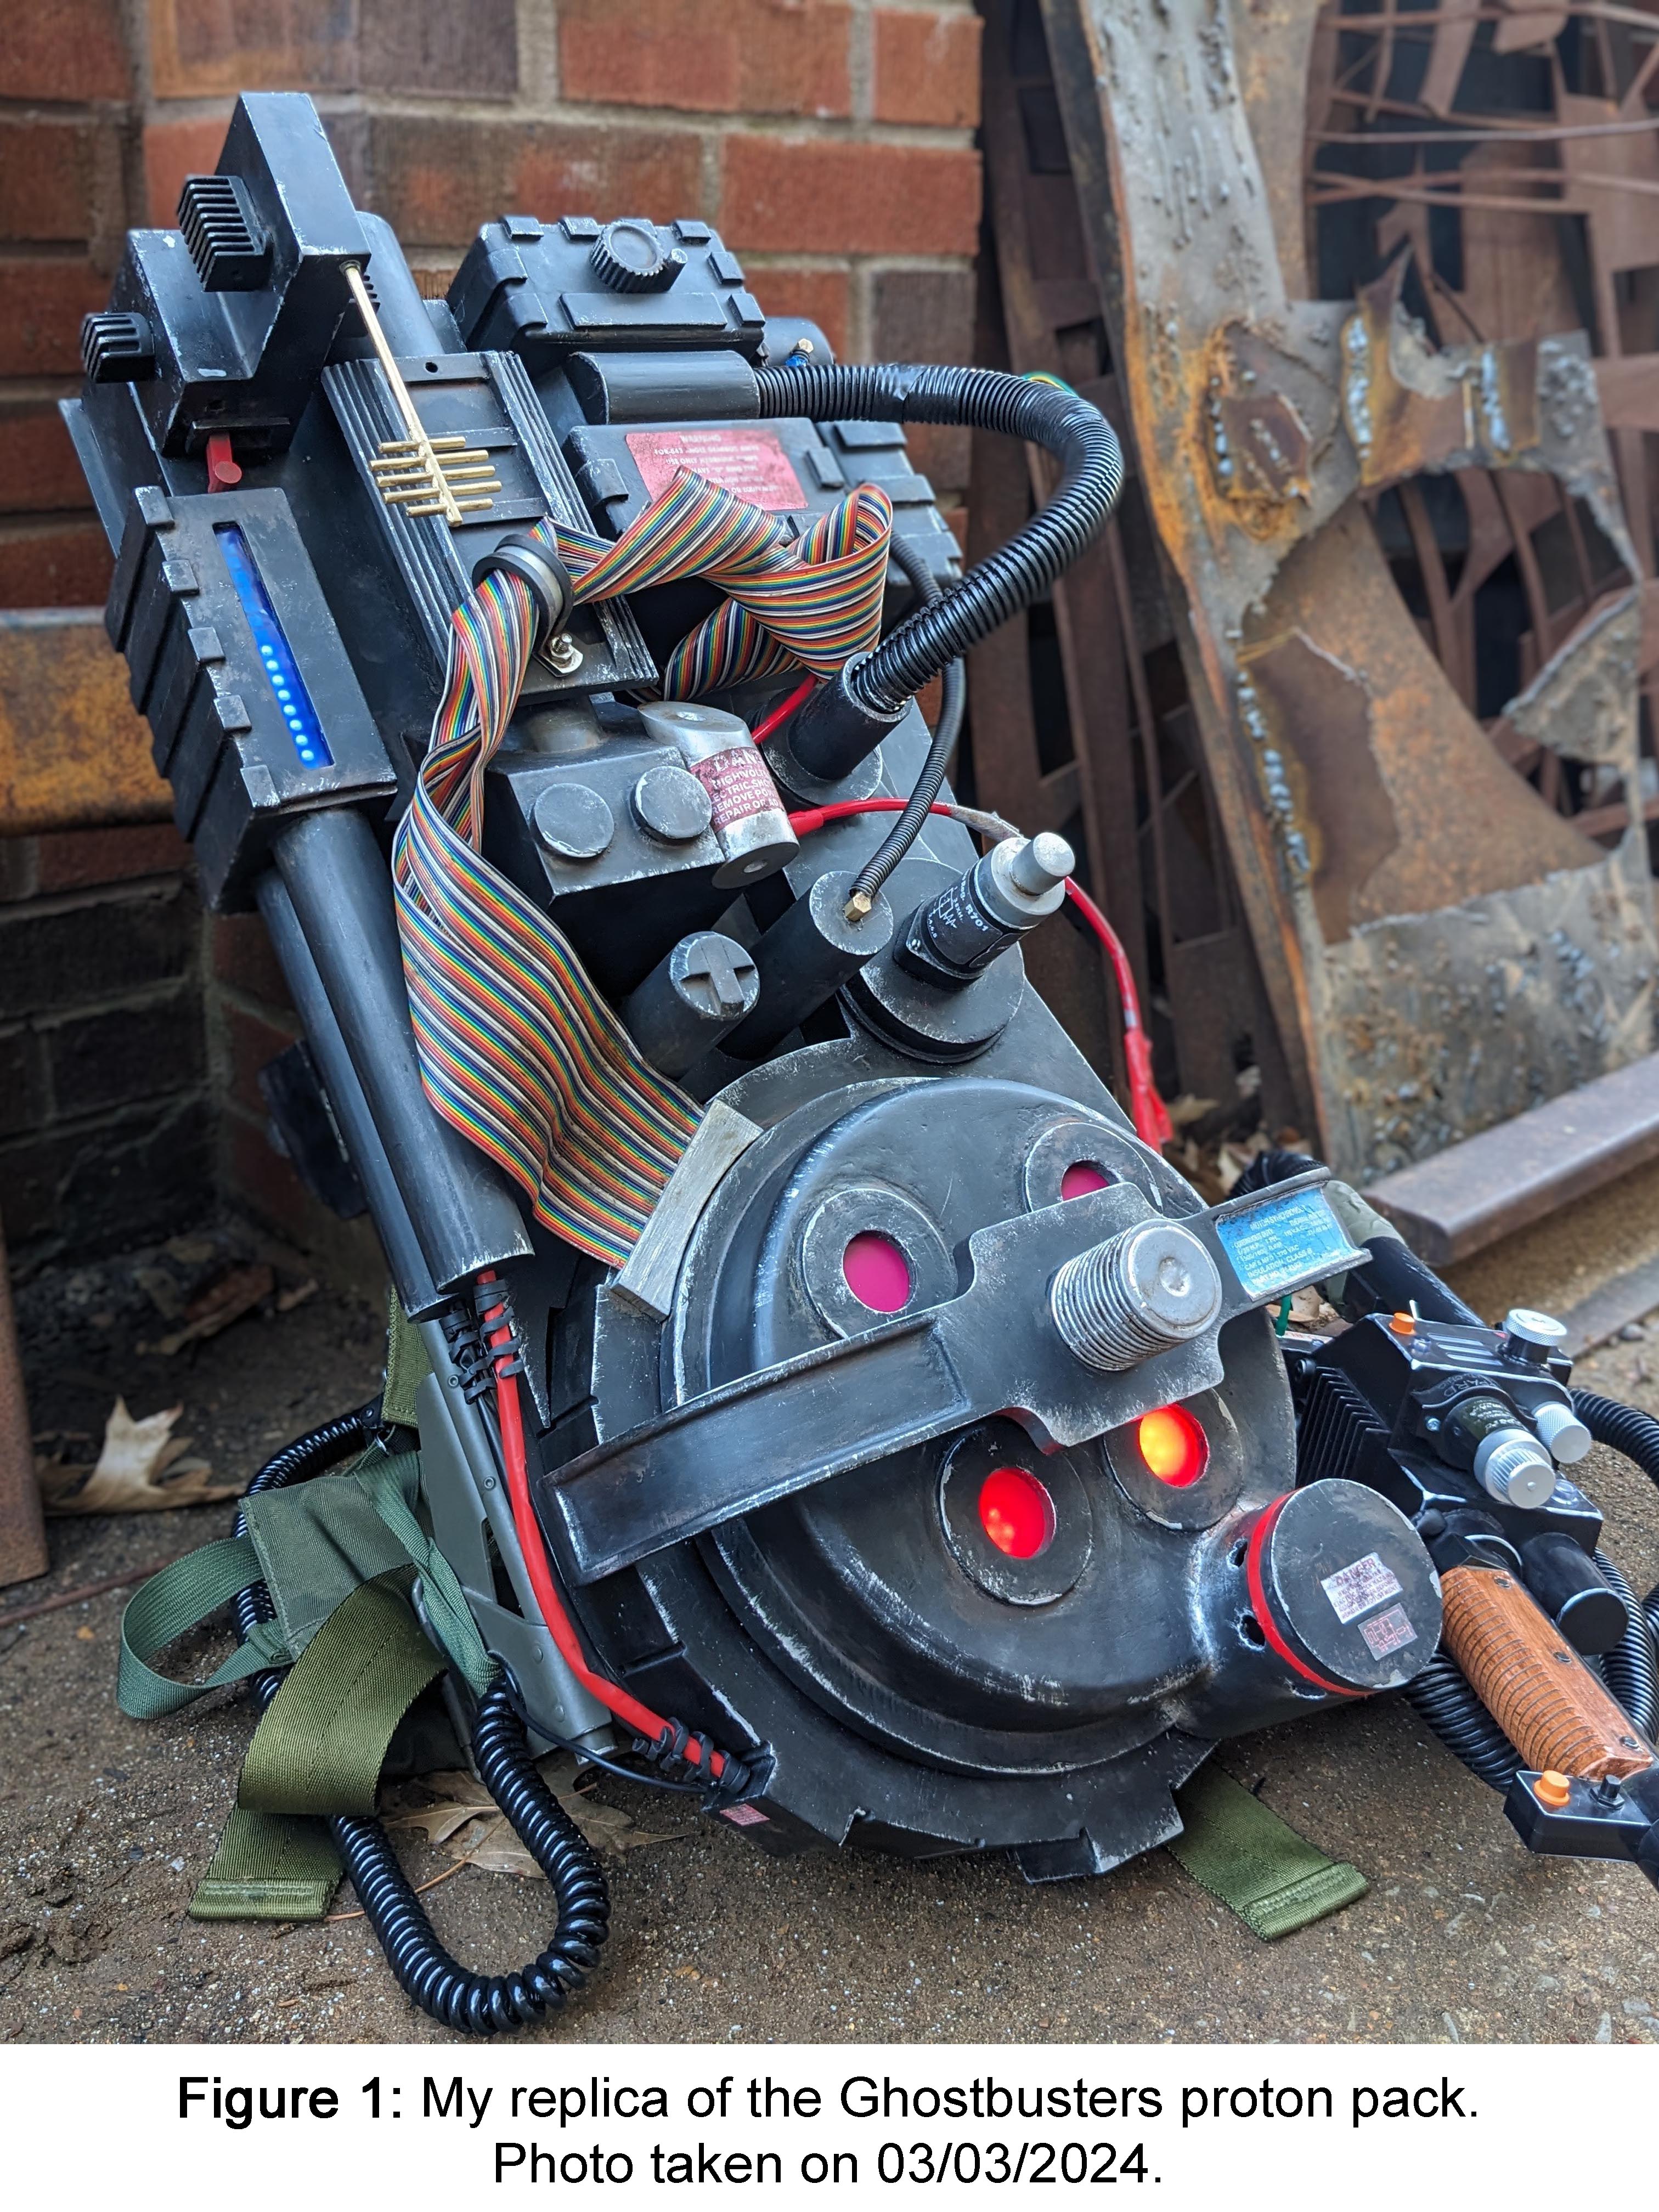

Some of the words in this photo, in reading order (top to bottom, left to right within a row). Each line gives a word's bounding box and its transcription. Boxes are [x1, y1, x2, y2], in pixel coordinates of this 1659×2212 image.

[713, 790, 755, 814] REMOVE
[714, 803, 751, 824] REPAIR
[966, 904, 989, 931] R701
[1285, 1250, 1307, 1262] CLASS
